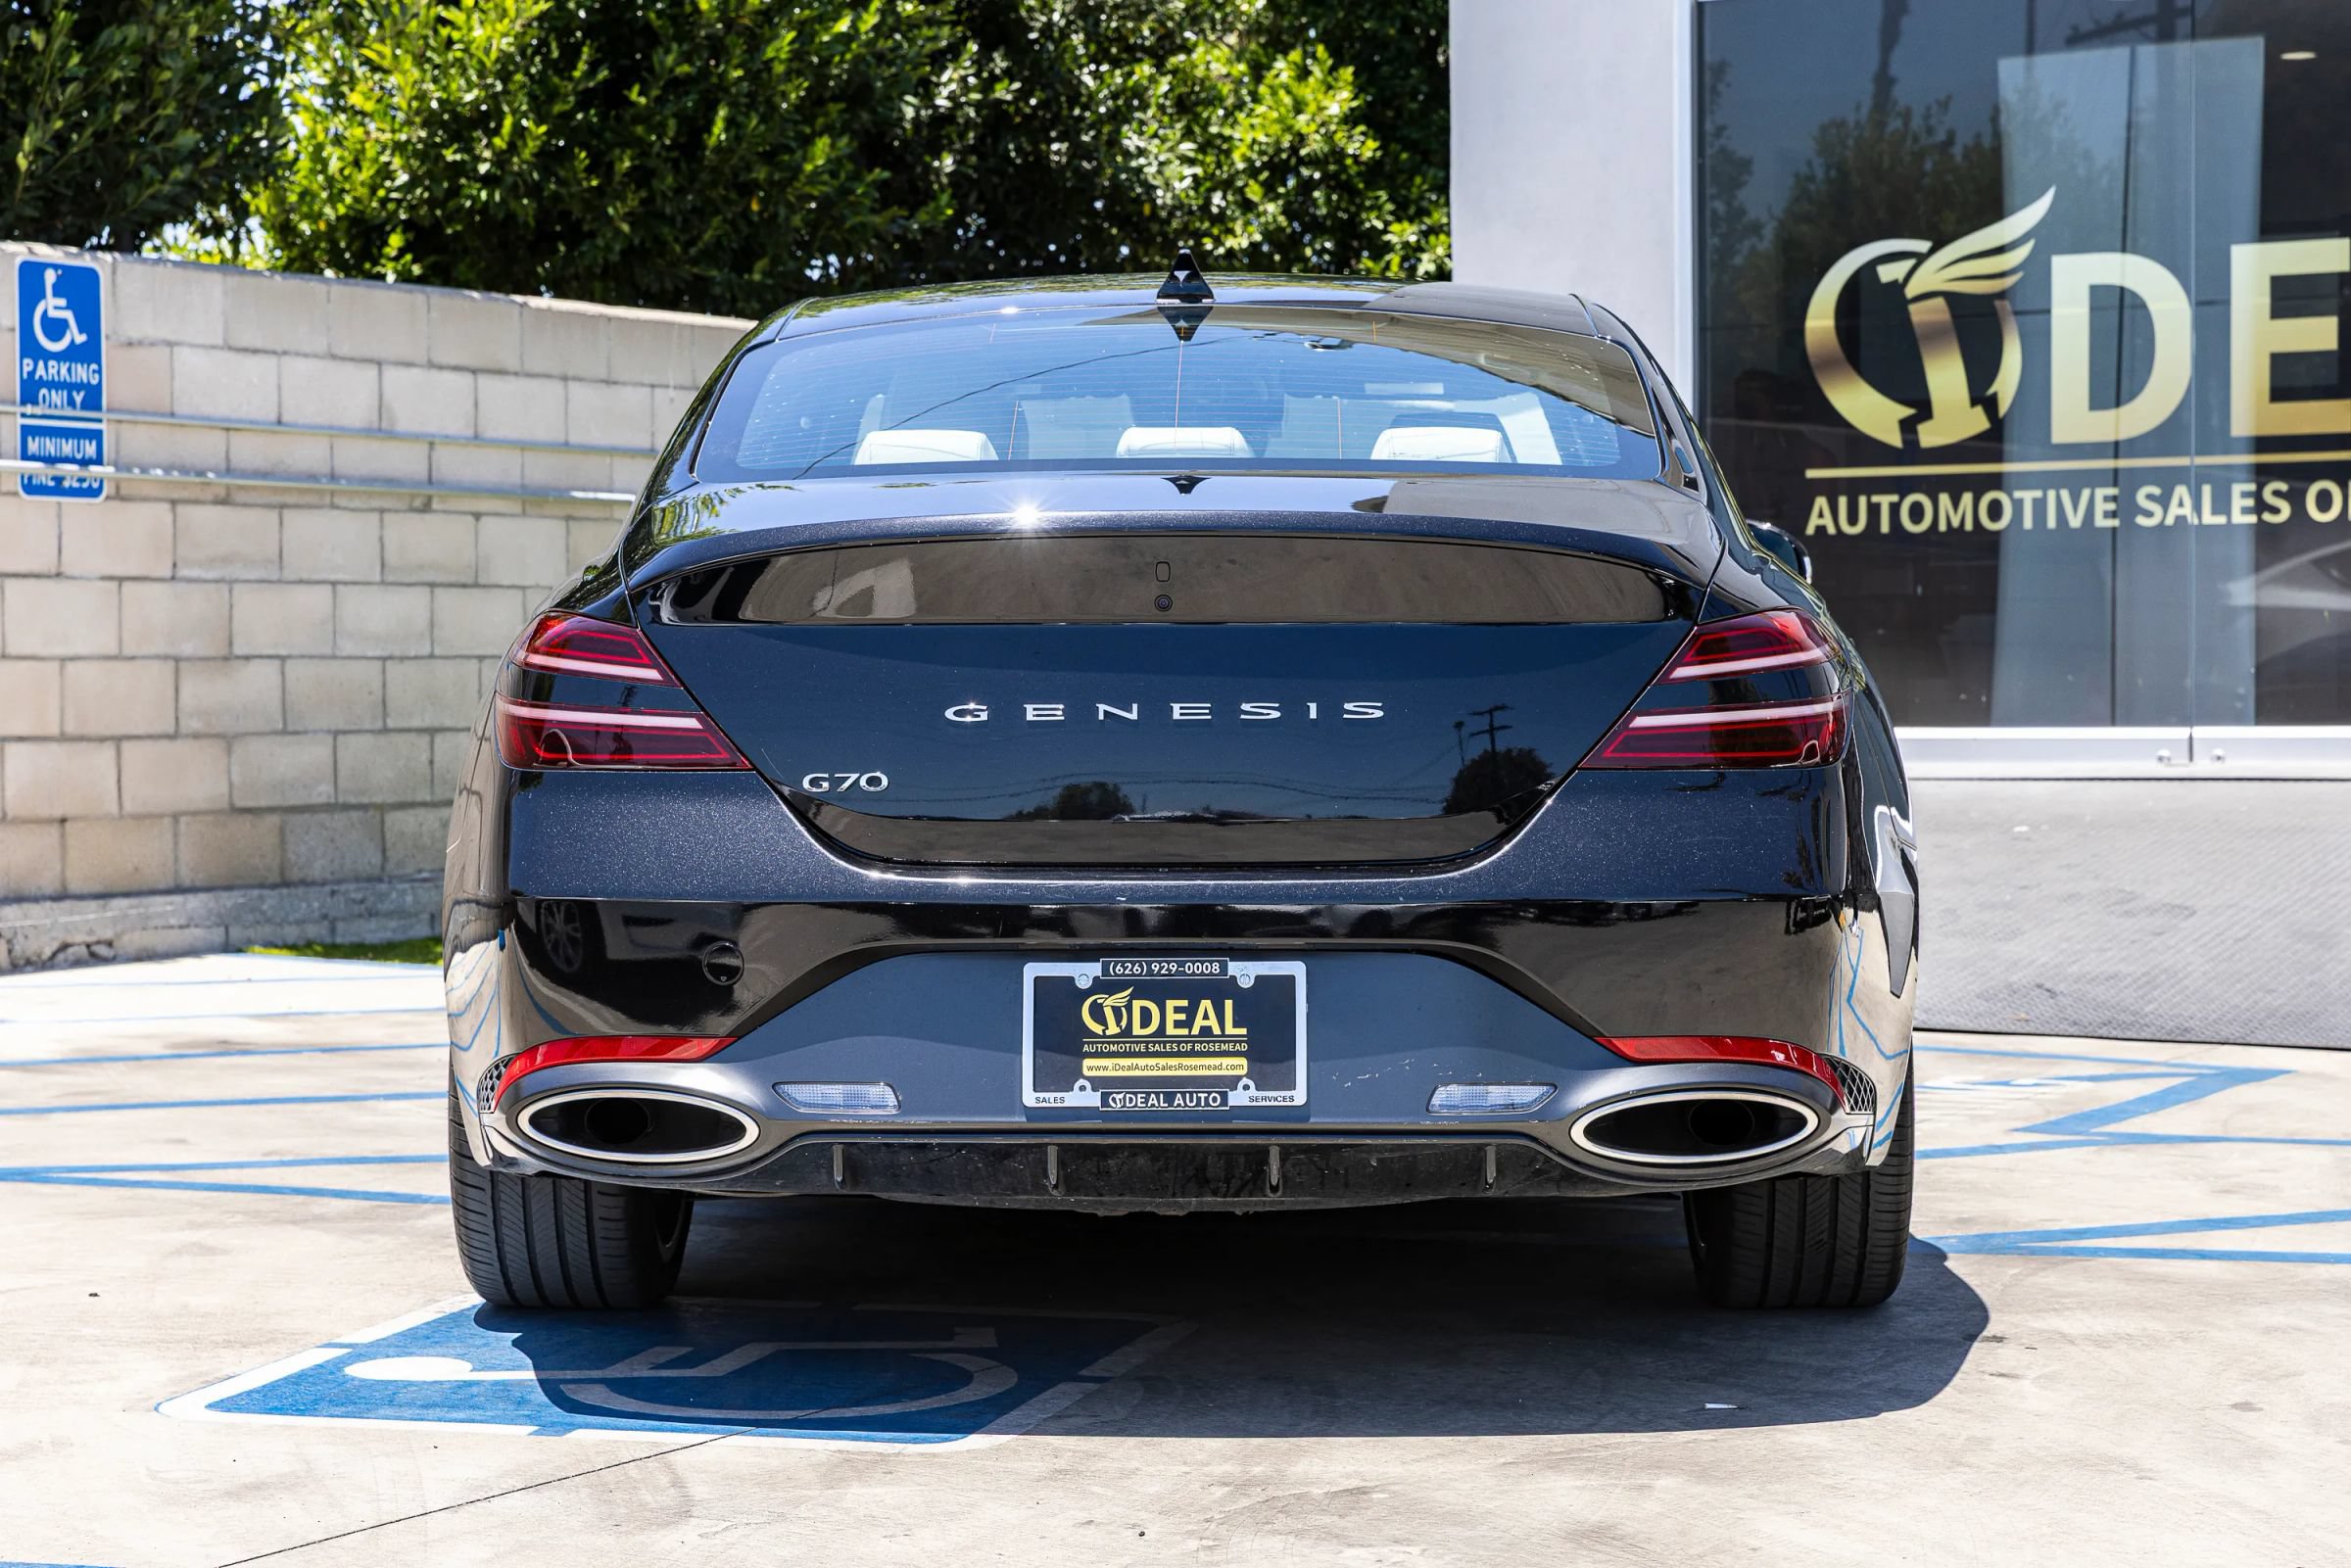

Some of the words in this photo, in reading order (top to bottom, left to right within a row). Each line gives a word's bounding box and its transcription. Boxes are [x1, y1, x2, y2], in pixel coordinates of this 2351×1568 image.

[23, 357, 100, 385] PARKING
[38, 388, 85, 411] ONLY
[27, 436, 97, 460] MINIMUM
[1804, 487, 2120, 536] AUTOMOTIVE
[2135, 480, 2292, 526] SALES
[2305, 479, 2351, 523] O
[944, 701, 1385, 723] GENESIS
[802, 772, 889, 792] G70
[1109, 961, 1147, 975] (626)
[1151, 962, 1221, 974] 929-0008
[1082, 1043, 1146, 1053] AUTOMOTIVE
[1147, 1043, 1178, 1052] SALES
[1179, 1043, 1193, 1052] OF
[1195, 1042, 1248, 1052] ROSEMEAD
[1086, 1062, 1244, 1072] www.iDealAutoSalesRosemead.com
[1034, 1096, 1066, 1105] SALES
[1174, 1092, 1222, 1108] AUTO
[1248, 1095, 1295, 1104] SERVICES
